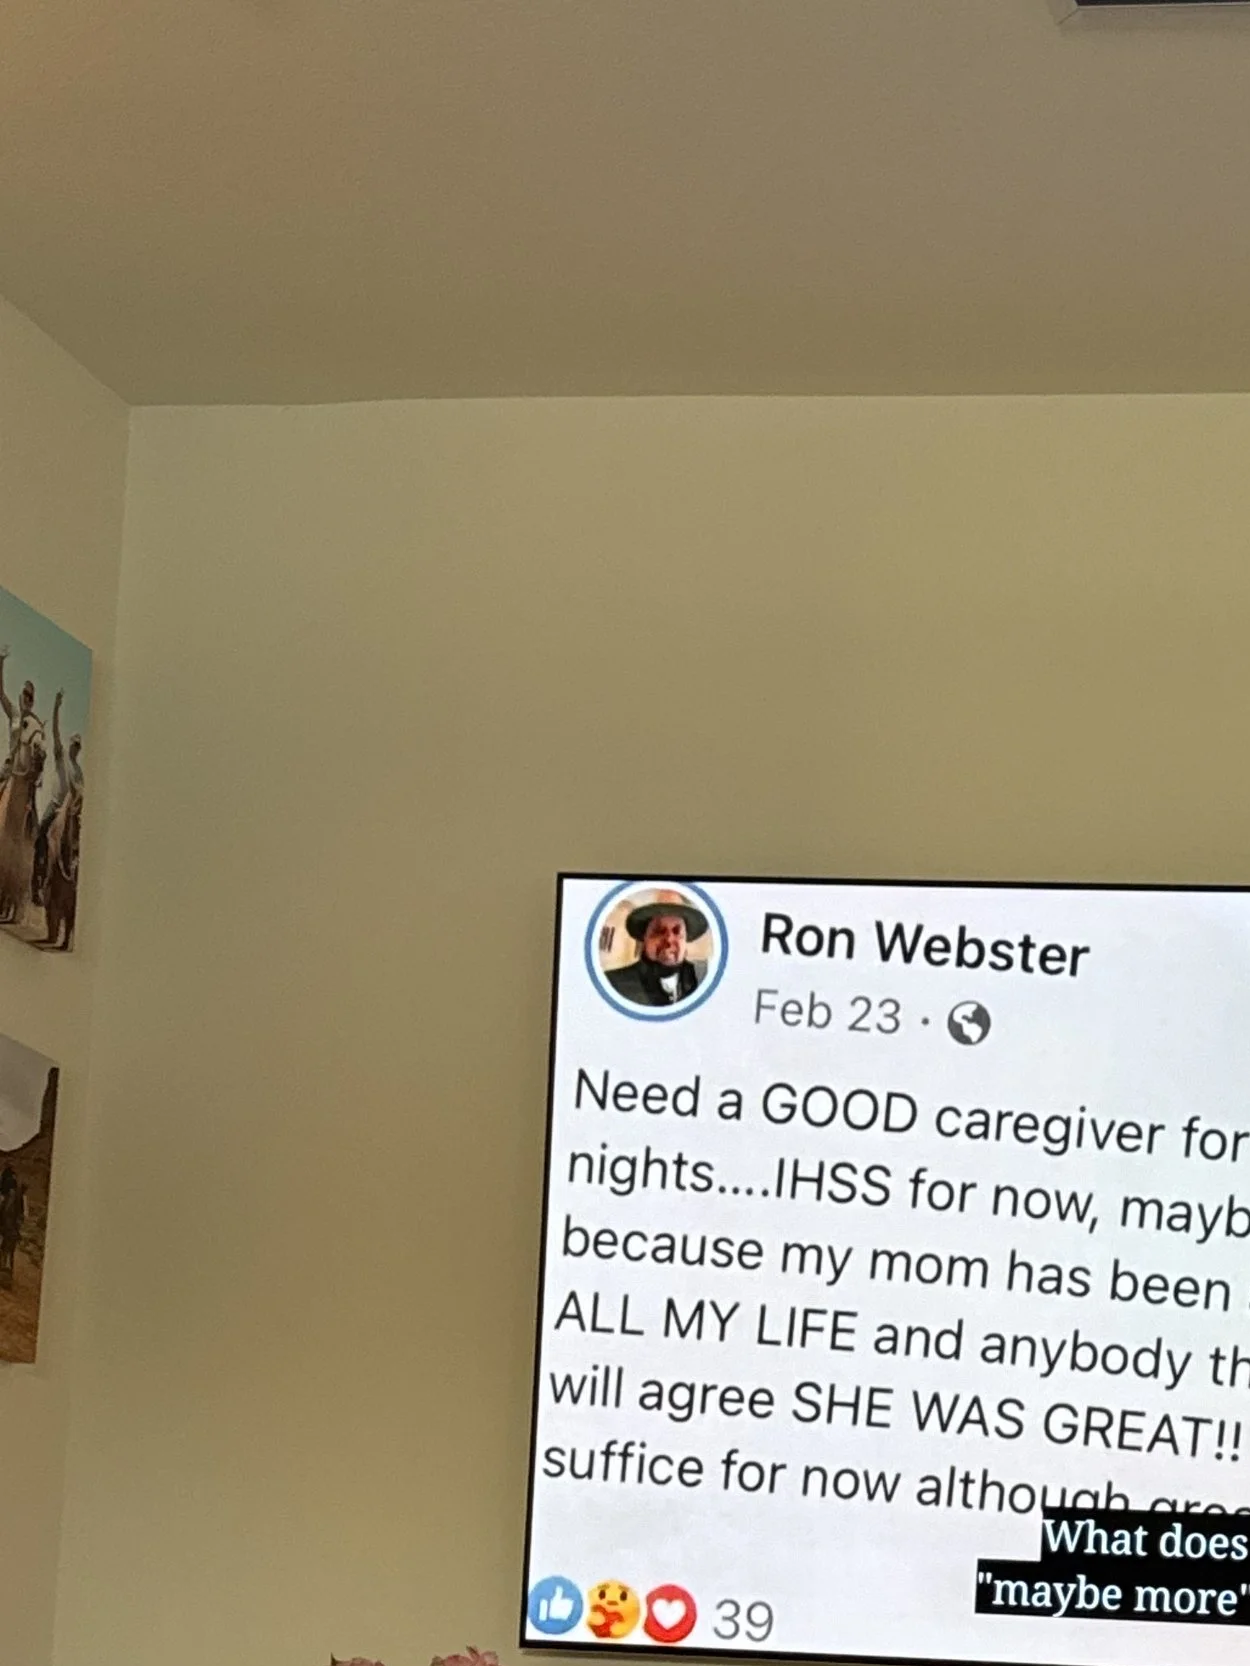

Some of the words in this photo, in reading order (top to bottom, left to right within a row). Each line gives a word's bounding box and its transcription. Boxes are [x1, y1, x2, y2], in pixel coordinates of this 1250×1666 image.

[762, 912, 855, 960] Ron
[875, 920, 1090, 977] Webster
[755, 989, 832, 1029] Feb
[848, 996, 900, 1034] 23
[575, 1068, 701, 1117] Need
[717, 1089, 743, 1121] a
[762, 1082, 918, 1133] GOOD
[935, 1105, 1166, 1156] caregiver
[1182, 1115, 1250, 1162] for
[909, 1167, 977, 1213] for
[992, 1184, 1098, 1234] now,
[563, 1214, 763, 1270] because
[781, 1242, 853, 1286] my
[870, 1249, 988, 1289] mom
[1007, 1249, 1091, 1298] has
[1110, 1258, 1230, 1312] been
[554, 1290, 644, 1336] ALL
[664, 1297, 740, 1342] MY
[757, 1304, 858, 1352] LIFE
[874, 1318, 963, 1360] and
[980, 1329, 1192, 1391] anybody
[550, 1364, 623, 1408] will
[639, 1380, 774, 1423] agree
[792, 1381, 894, 1428] SHE
[912, 1390, 1025, 1440] WAS
[1044, 1403, 1241, 1462] GREAT!!
[543, 1439, 703, 1488] suffice
[721, 1448, 787, 1494] for
[802, 1465, 901, 1503] now
[1042, 1519, 1148, 1557] What
[1159, 1523, 1248, 1560] does
[714, 1599, 773, 1642] 39
[978, 1571, 1122, 1617] "maybe
